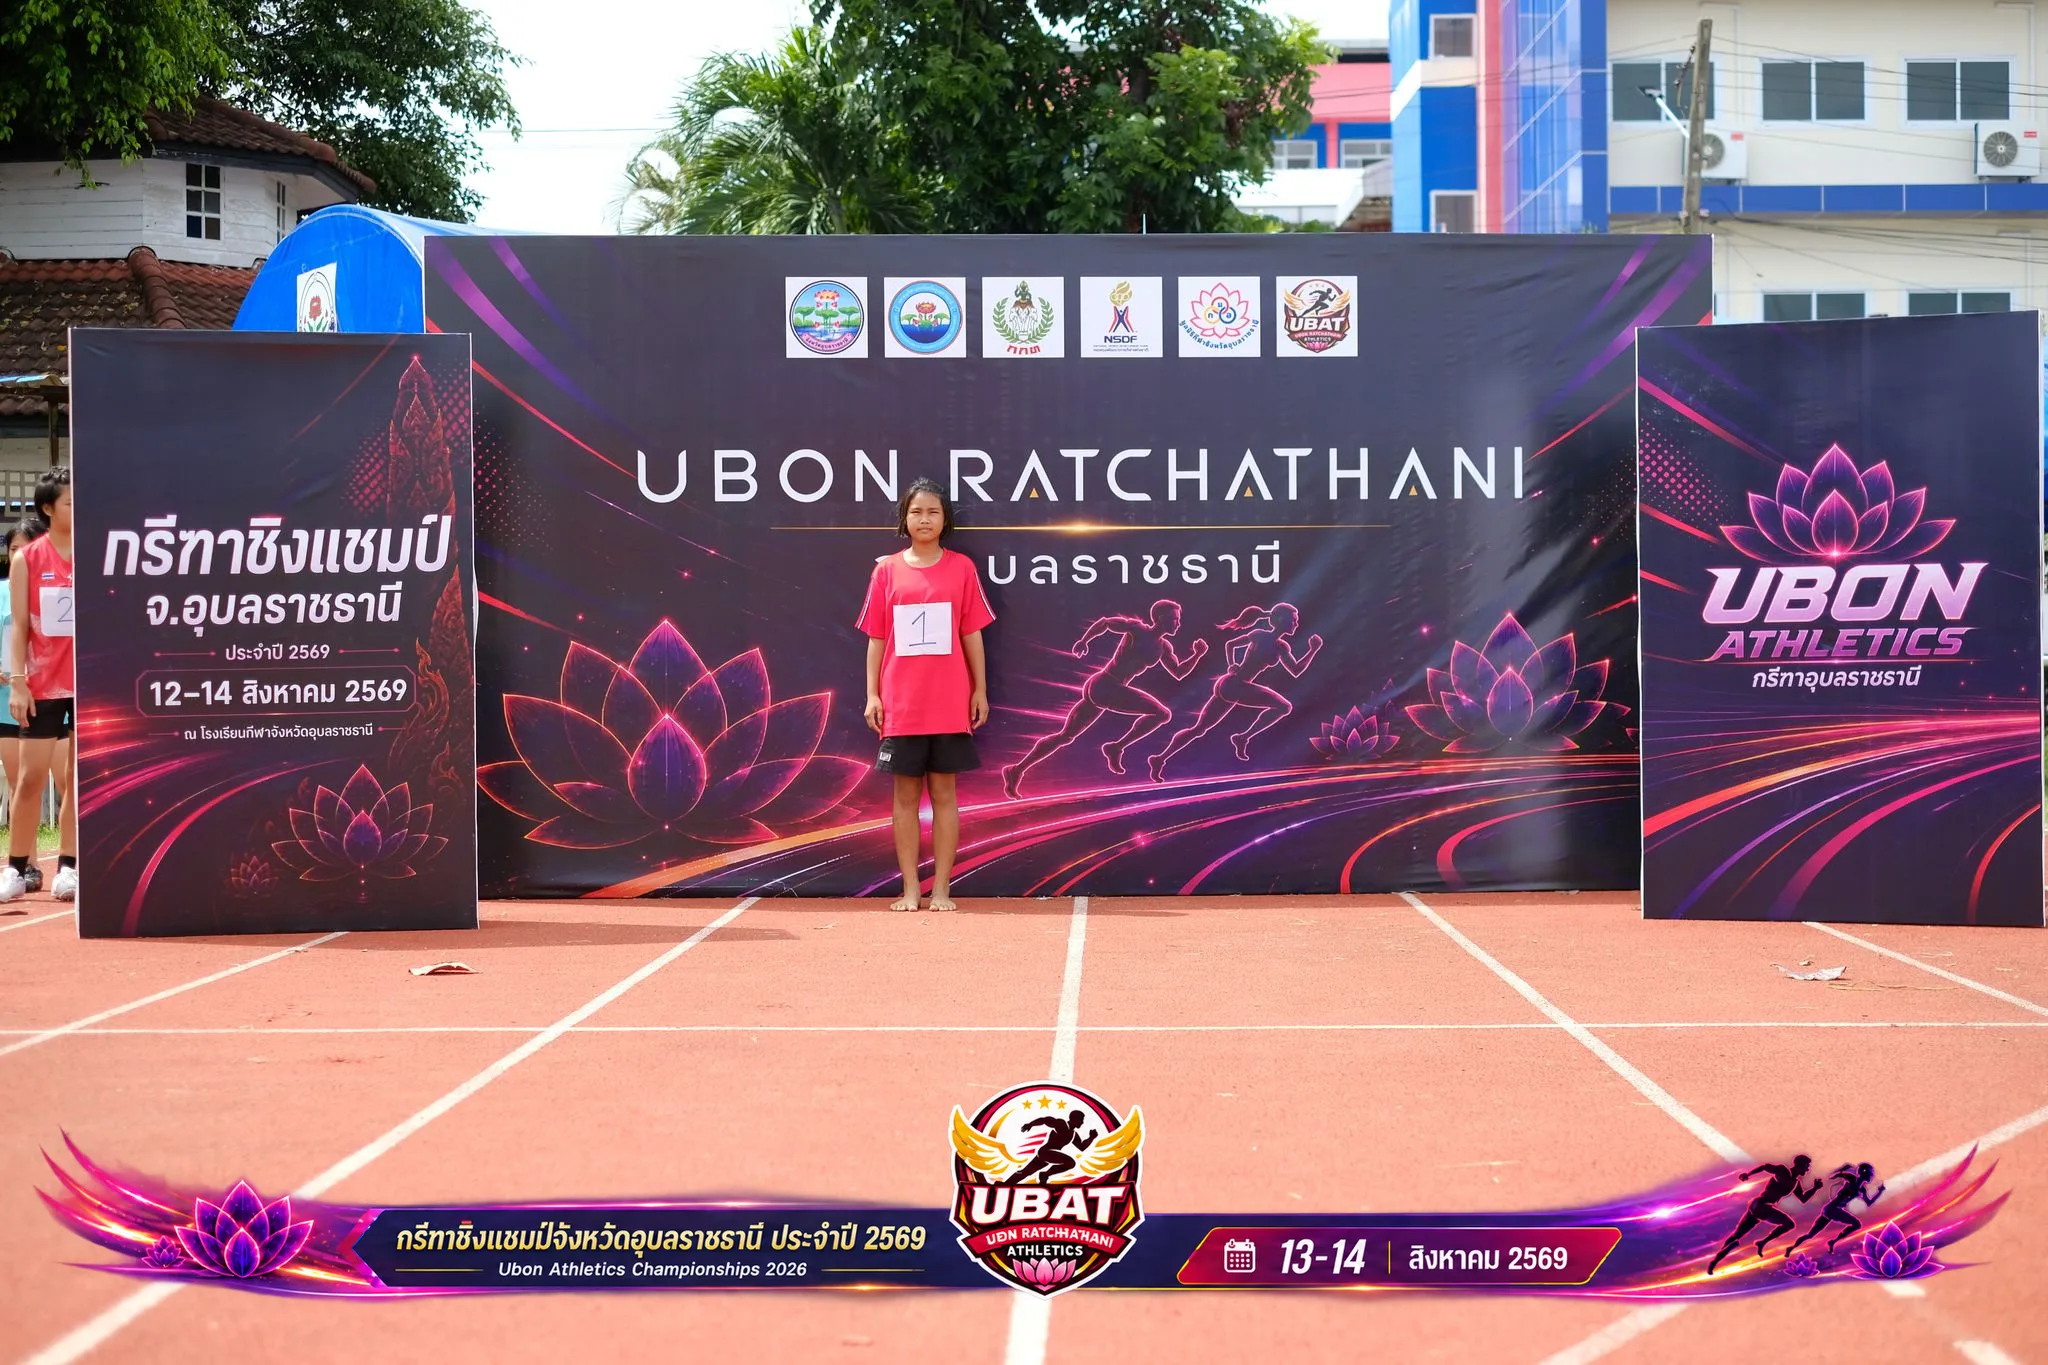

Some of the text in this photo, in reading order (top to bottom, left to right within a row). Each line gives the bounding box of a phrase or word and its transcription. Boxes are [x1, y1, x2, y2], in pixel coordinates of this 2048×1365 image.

[1104, 335, 1137, 344] NSDF
[1289, 317, 1345, 332] UBAT
[637, 446, 1524, 503] UBON RATCHATHANI
[103, 514, 453, 576] กรีฑาชิงแชมป์
[146, 580, 403, 638] จ.อุบลราชธานี
[1702, 562, 1990, 624] UBON
[909, 611, 936, 646] 1
[1705, 627, 1980, 662] ATHLETICS
[225, 643, 330, 661] ประจำปี 2569
[242, 679, 336, 705] สิงหาคม
[344, 678, 407, 702] 2569
[1752, 664, 1922, 693] กรีฑาอุบลราชธานี
